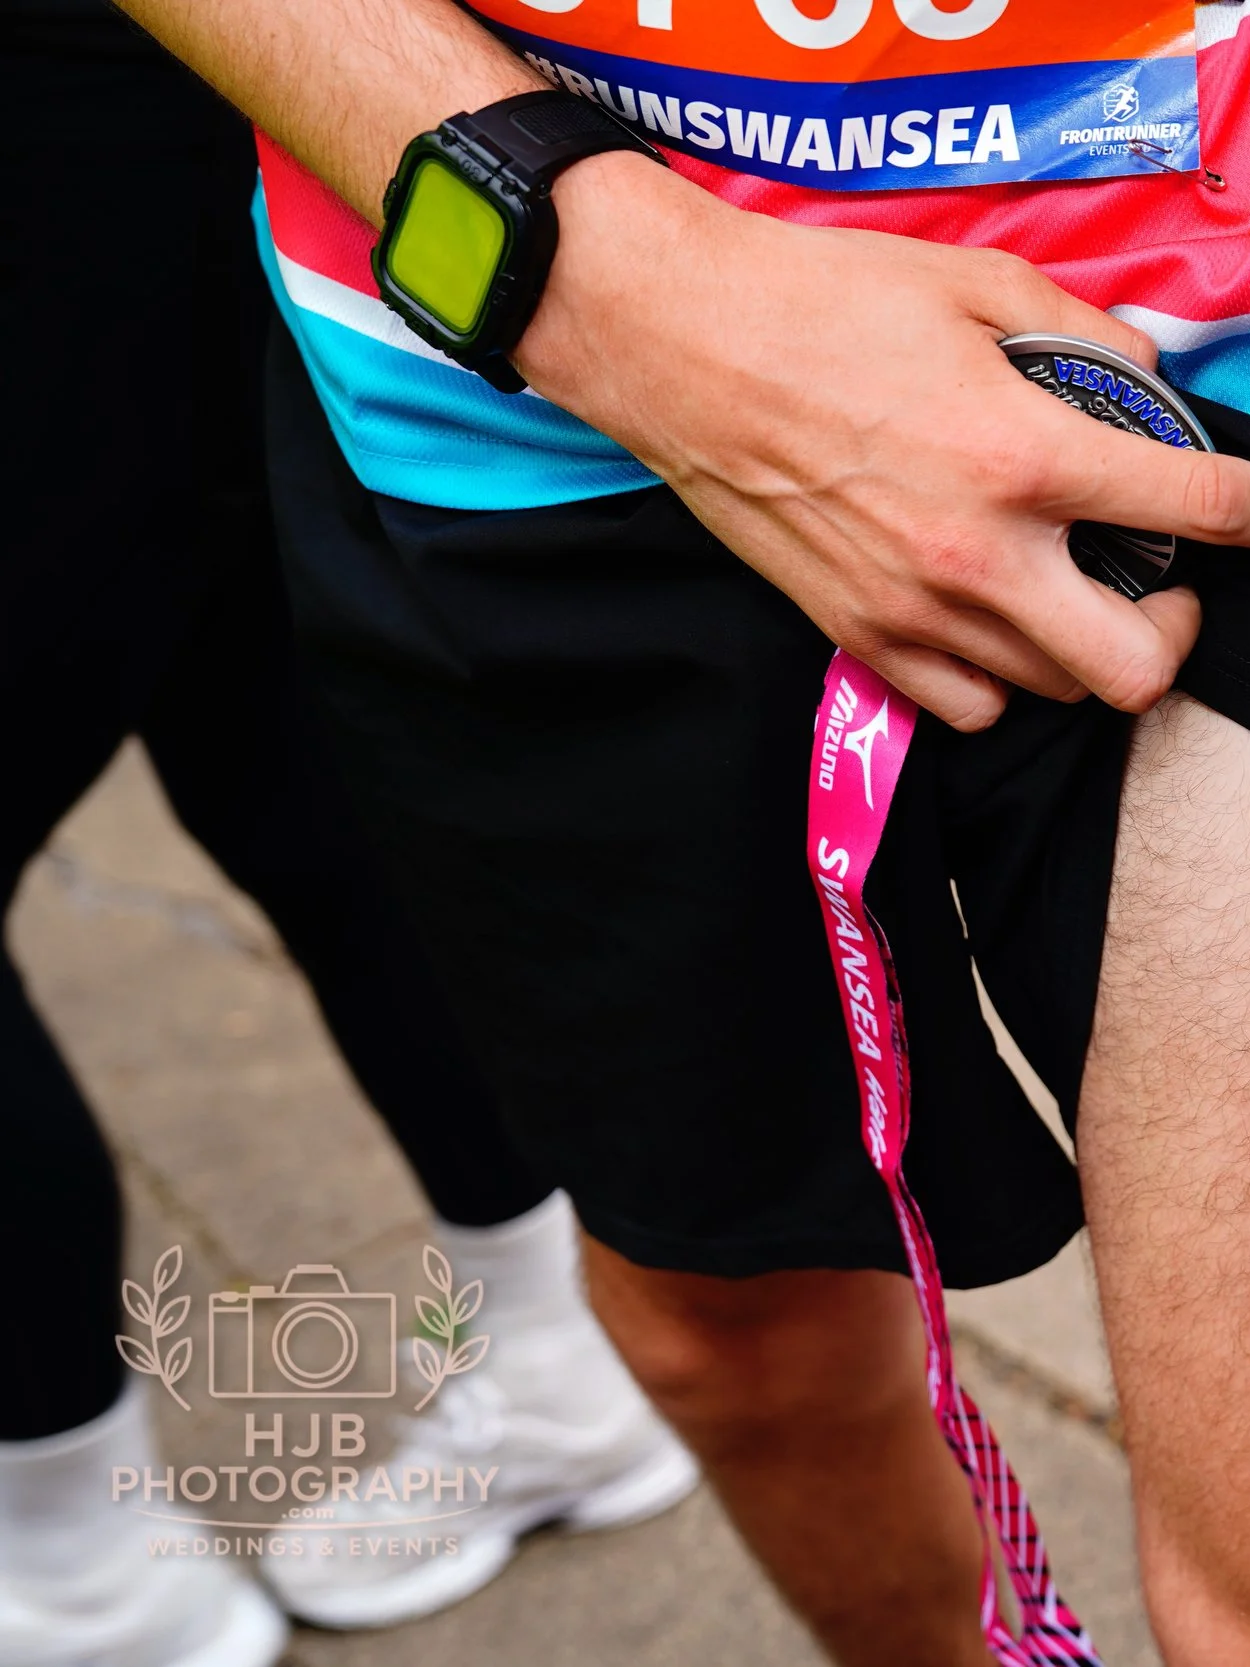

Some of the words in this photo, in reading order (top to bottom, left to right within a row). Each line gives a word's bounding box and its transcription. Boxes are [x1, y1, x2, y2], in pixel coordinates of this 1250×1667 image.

[524, 51, 1020, 172] #RUNSWANSEA
[1060, 123, 1181, 144] FRONTRUNNER
[1089, 144, 1129, 156] EVENTS
[1053, 356, 1195, 450] NSWANSEA
[818, 836, 882, 1061] SWANSEA
